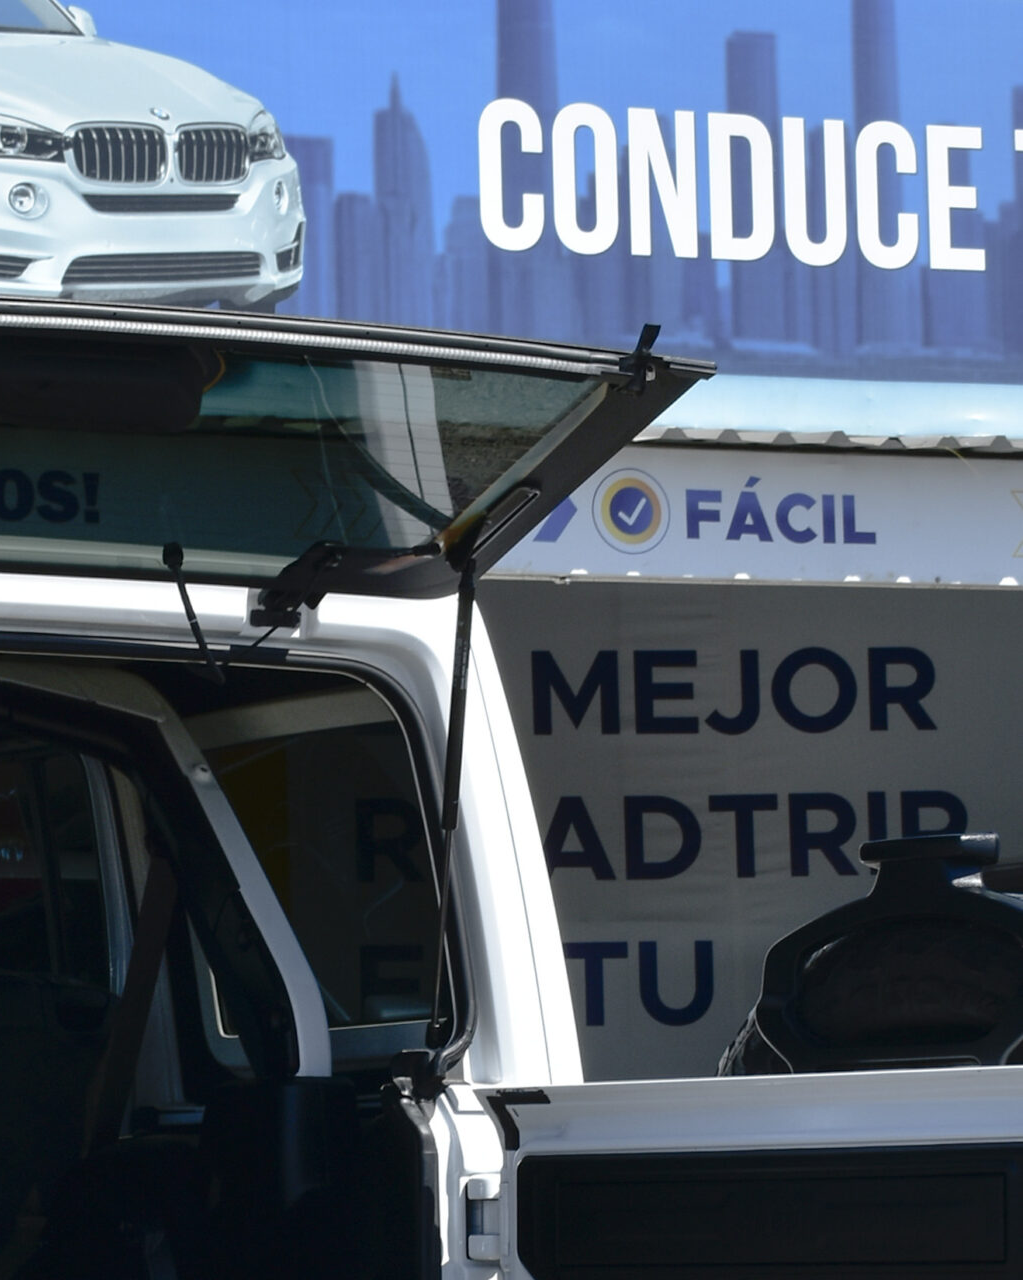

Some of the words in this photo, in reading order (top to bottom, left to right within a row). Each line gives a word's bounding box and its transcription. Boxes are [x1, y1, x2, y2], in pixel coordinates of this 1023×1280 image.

[478, 98, 986, 271] CONDUCE
[685, 475, 877, 545] FÁCIL
[530, 646, 938, 736] MEJOR
[565, 939, 714, 1028] TU
